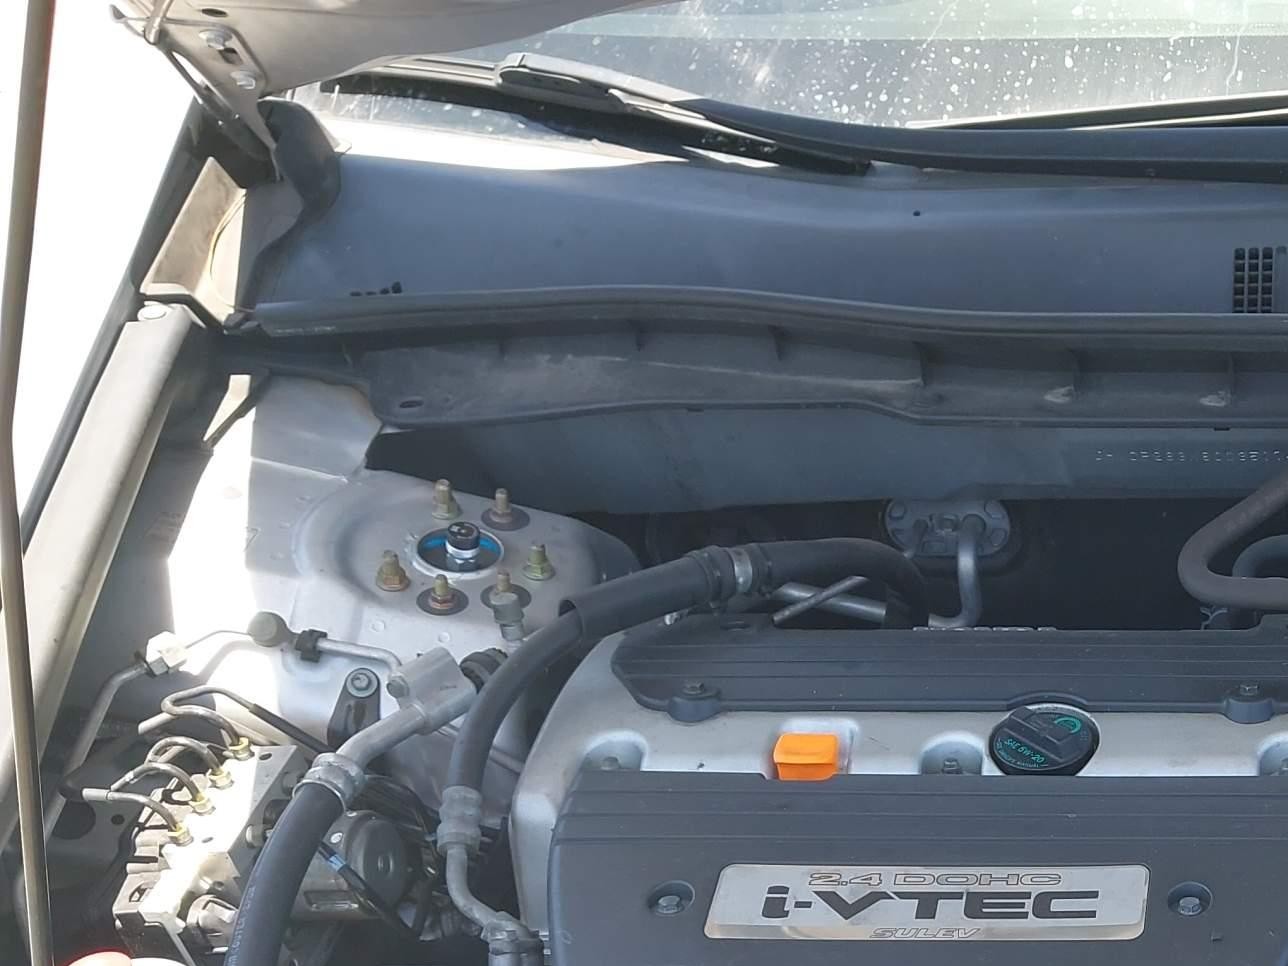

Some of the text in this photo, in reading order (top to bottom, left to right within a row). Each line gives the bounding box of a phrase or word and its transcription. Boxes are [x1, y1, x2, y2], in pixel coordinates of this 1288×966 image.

[808, 872, 1065, 887] 2.4 DOHC
[761, 885, 1101, 920] i-VTEC
[870, 926, 983, 940] SULEV
